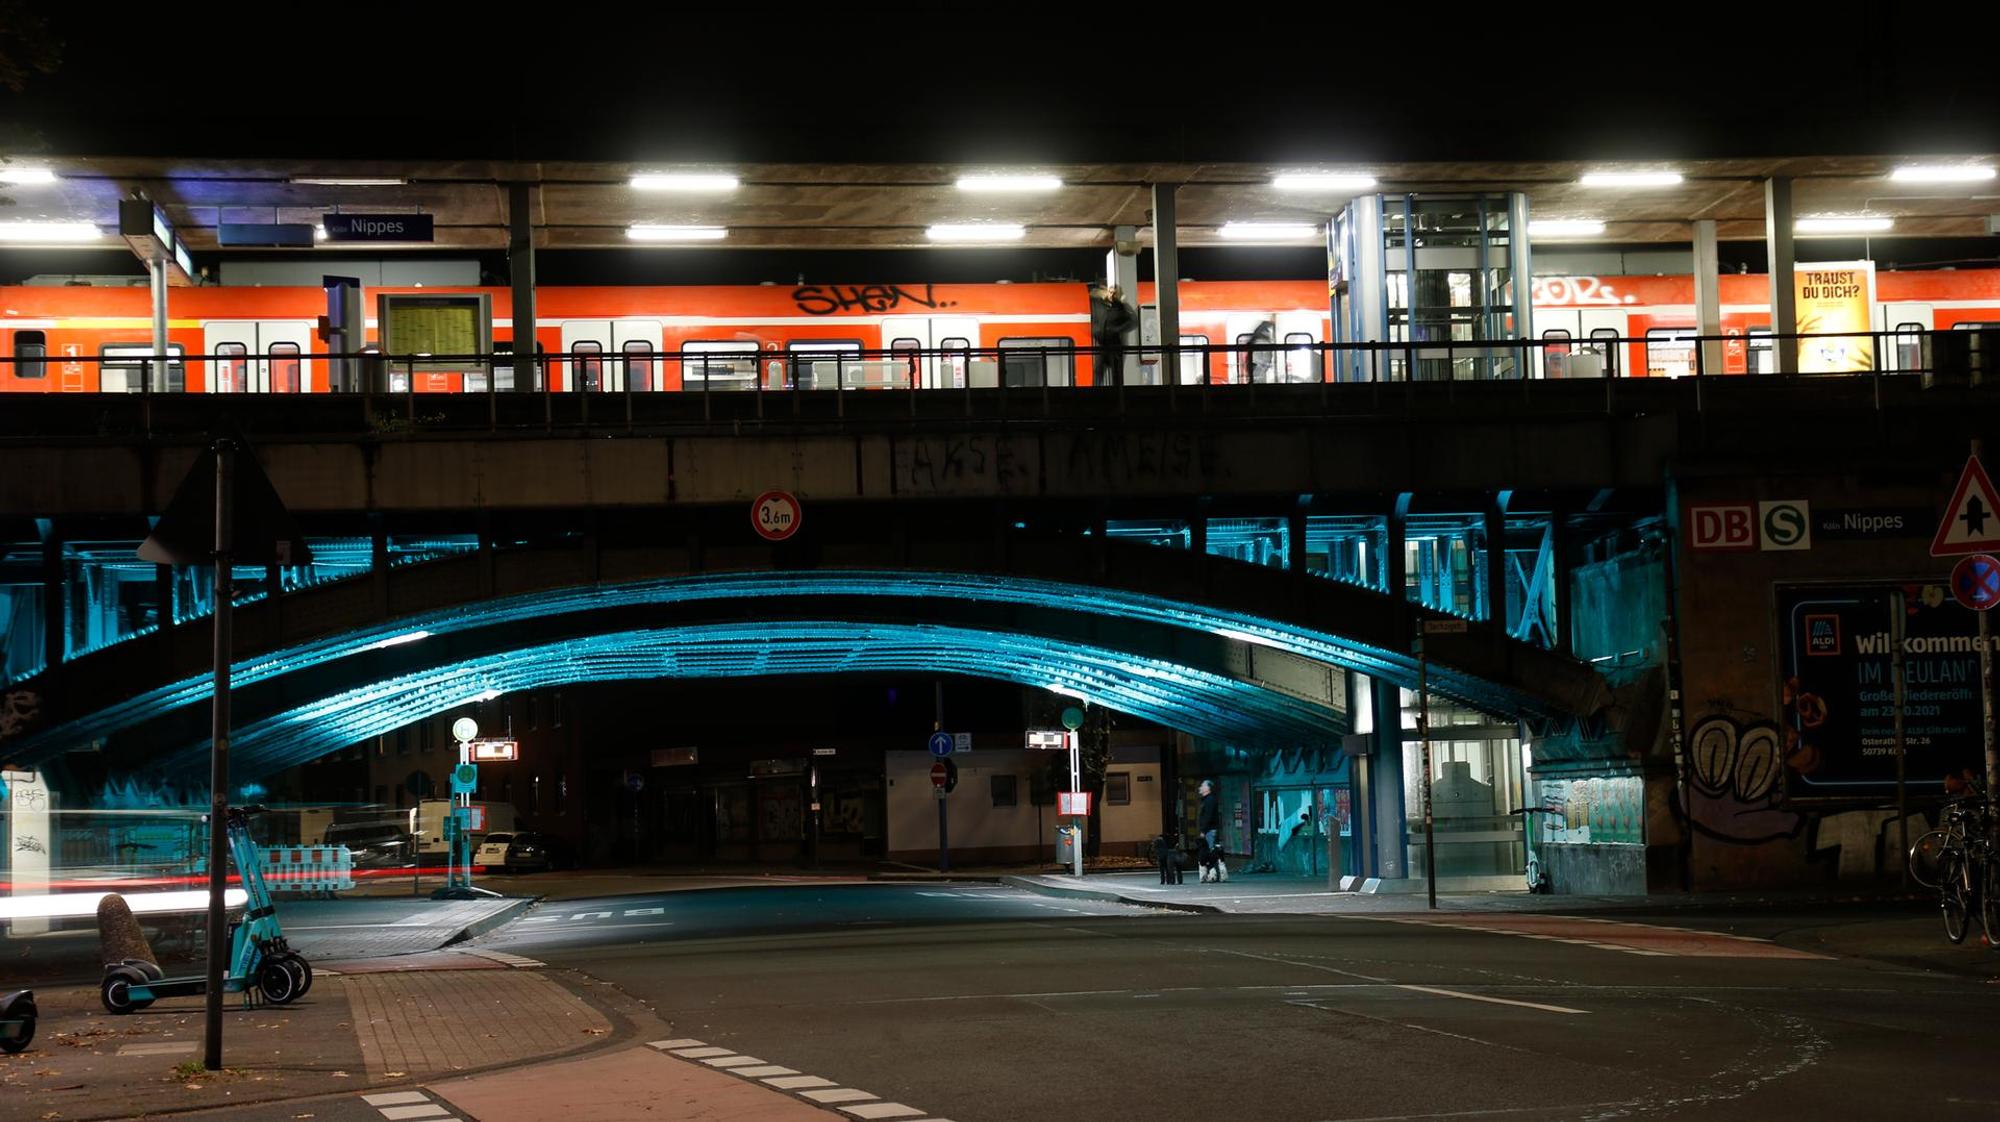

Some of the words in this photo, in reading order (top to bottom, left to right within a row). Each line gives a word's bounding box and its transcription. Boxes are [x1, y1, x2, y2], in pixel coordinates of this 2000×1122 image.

[351, 218, 404, 236] Nippes
[1806, 272, 1856, 286] TRAUST
[1803, 286, 1819, 299] DU
[1823, 285, 1860, 299] DICH?
[1696, 510, 1750, 543] DB
[1772, 506, 1800, 543] S
[1843, 512, 1904, 533] Nippes
[1858, 661, 1882, 684] IM
